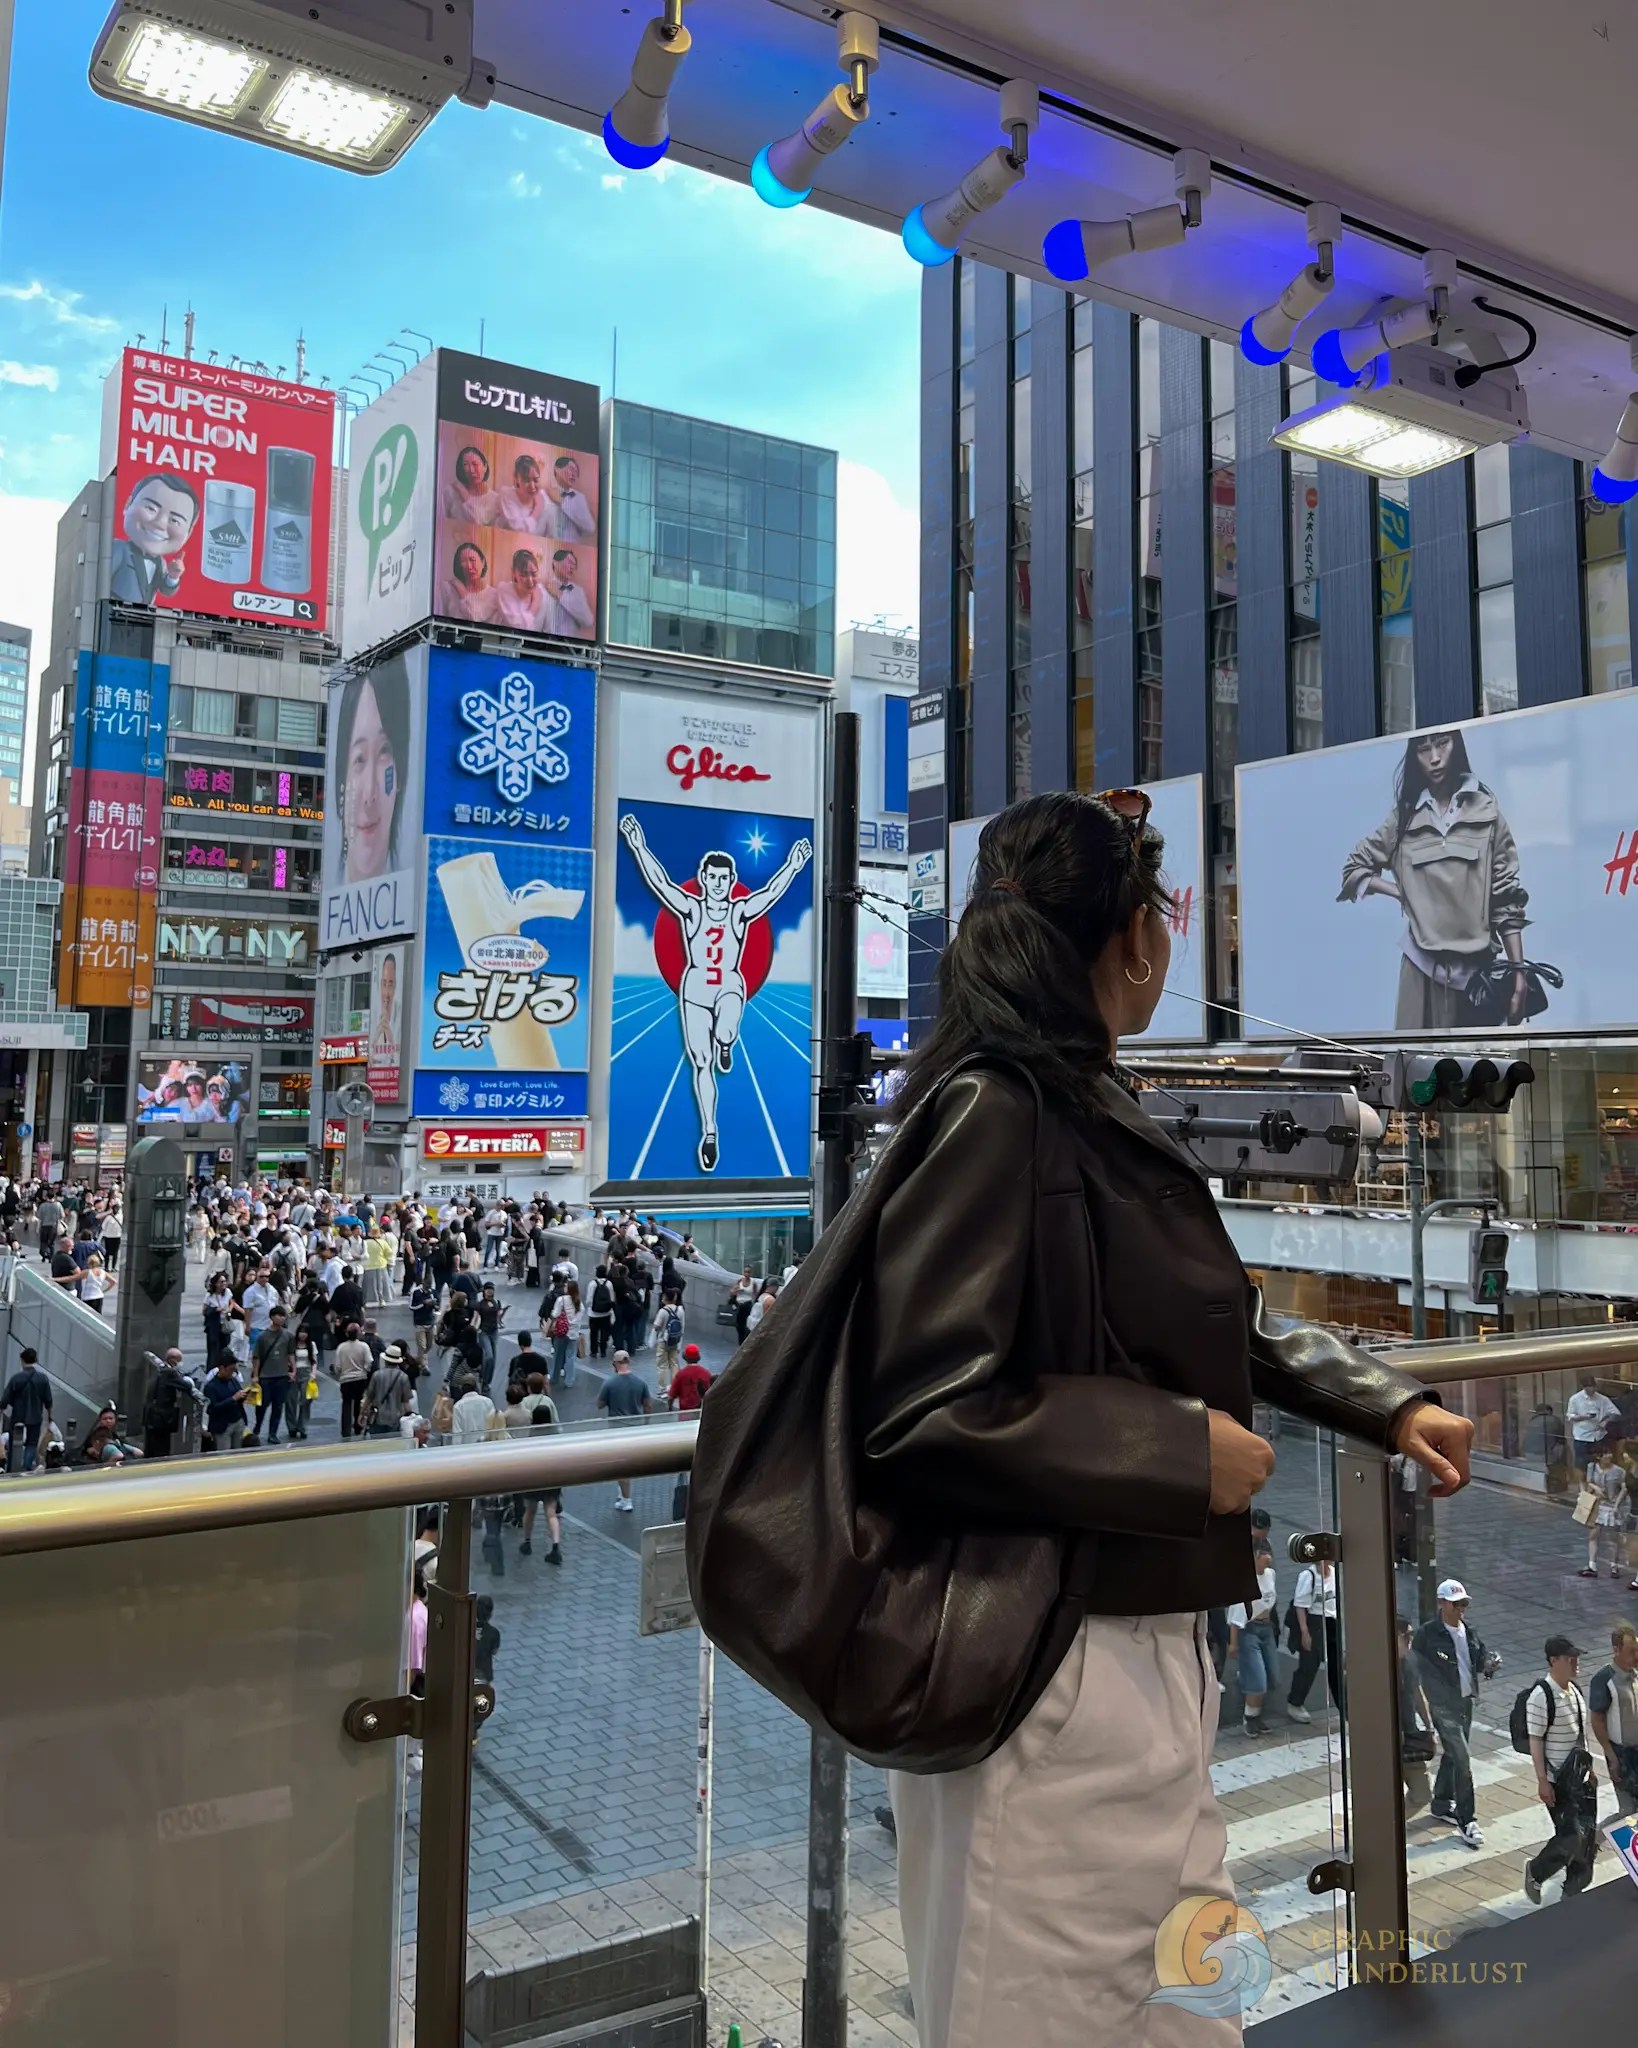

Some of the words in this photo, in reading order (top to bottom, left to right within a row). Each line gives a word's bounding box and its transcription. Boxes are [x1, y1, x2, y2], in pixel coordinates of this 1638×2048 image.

[133, 378, 248, 424] SUPER
[464, 380, 573, 425] ピップエレキバン
[131, 408, 258, 455] MILLION
[129, 438, 217, 476] HAIR
[218, 532, 241, 545] SMH
[379, 539, 416, 598] ピップ
[239, 595, 282, 610] ルアン
[879, 662, 919, 681] エステ
[95, 684, 154, 713] 龍角散
[184, 767, 232, 794] 焼肉
[666, 744, 772, 790] Glico
[88, 799, 147, 827] 龍角散
[208, 798, 224, 811] All
[228, 803, 250, 812] you
[253, 805, 273, 815] can
[454, 803, 571, 832] 雪印メグミルク
[327, 881, 405, 940] FANCL
[81, 917, 141, 943] 龍角散
[160, 923, 220, 955] NY
[248, 927, 305, 959] NY
[705, 923, 726, 987] グリコ
[434, 969, 578, 1024] さける
[433, 1023, 490, 1049] チーズ
[480, 1081, 497, 1089] Love
[499, 1081, 523, 1089] Earth.
[474, 1092, 565, 1108] 雪印メグミルク
[453, 1135, 542, 1153] ZETTERIA
